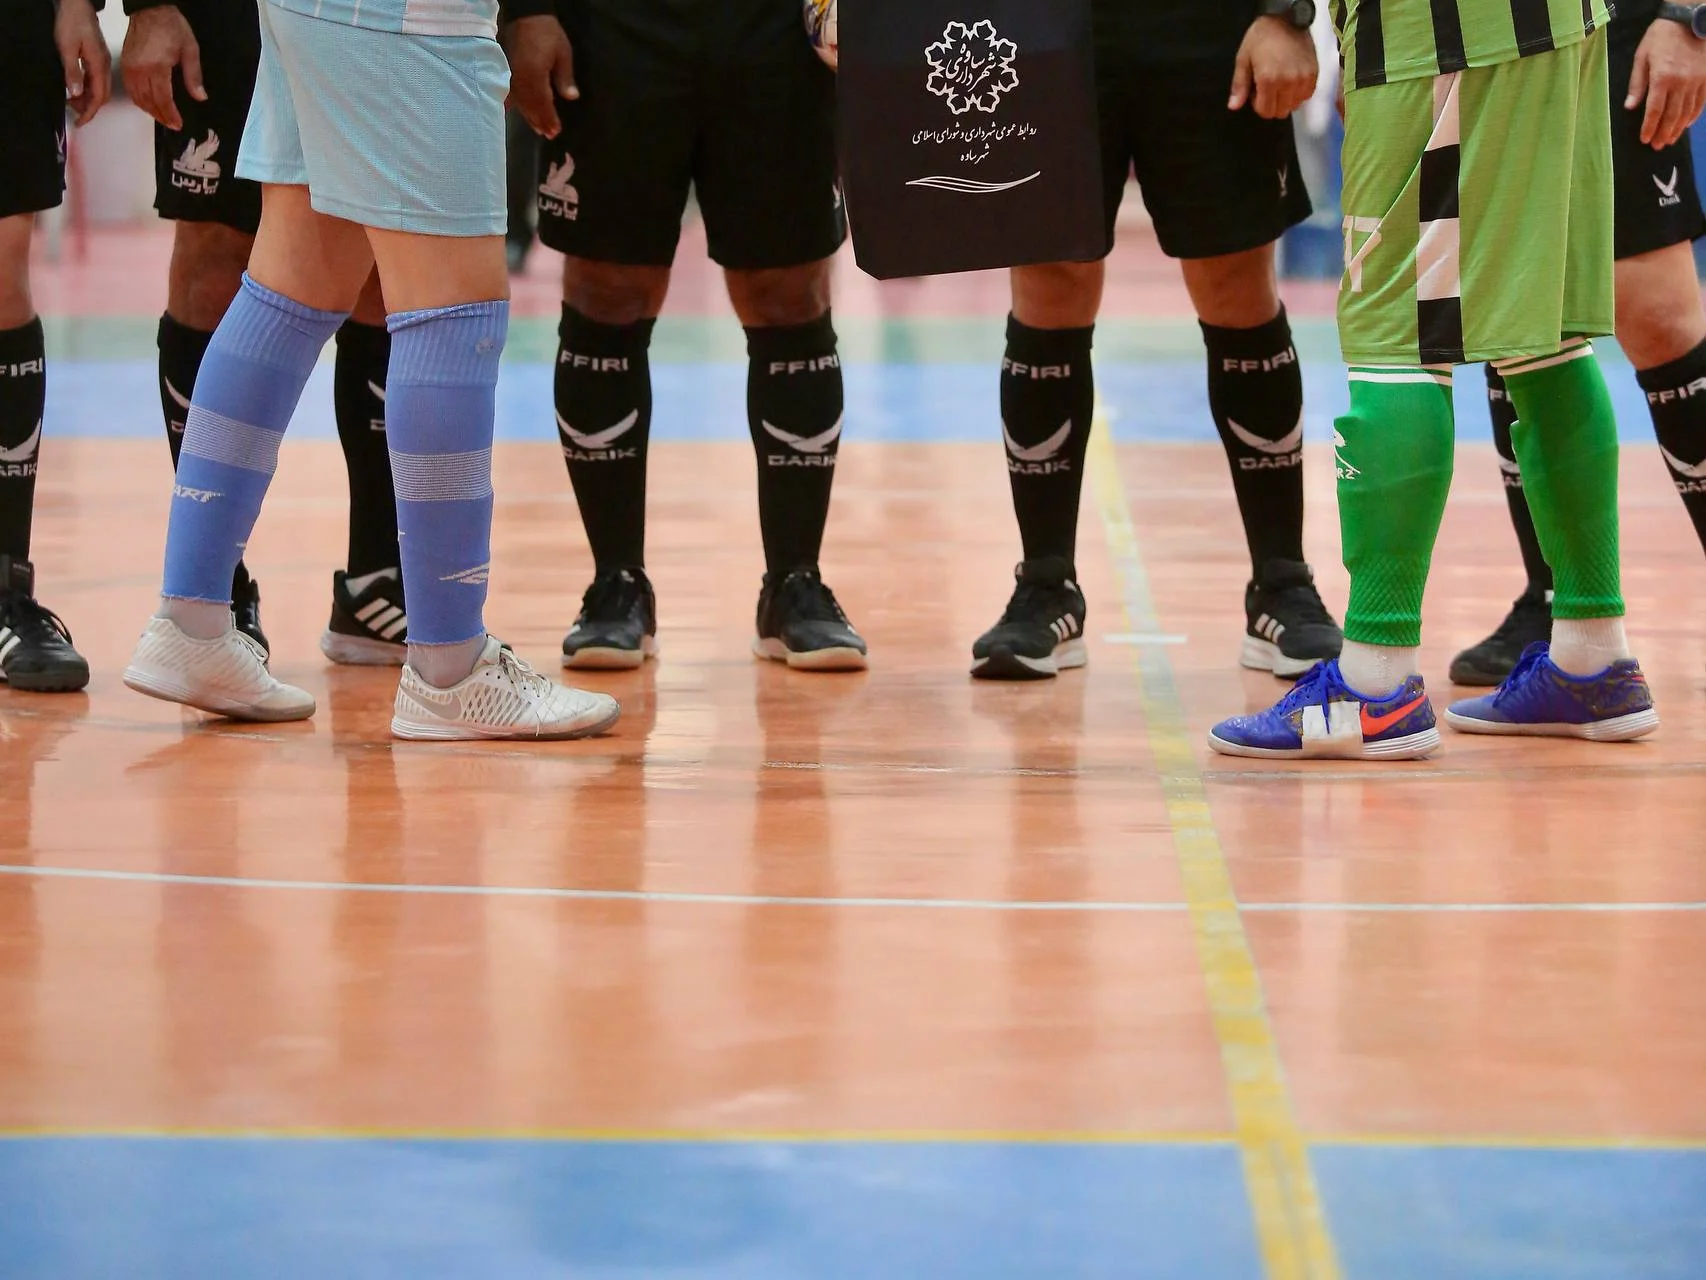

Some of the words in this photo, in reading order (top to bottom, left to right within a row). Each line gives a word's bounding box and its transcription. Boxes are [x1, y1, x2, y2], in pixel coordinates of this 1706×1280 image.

[560, 349, 629, 372] FFIRI
[769, 354, 840, 375] FFIRI
[1223, 346, 1296, 373] FFIRI
